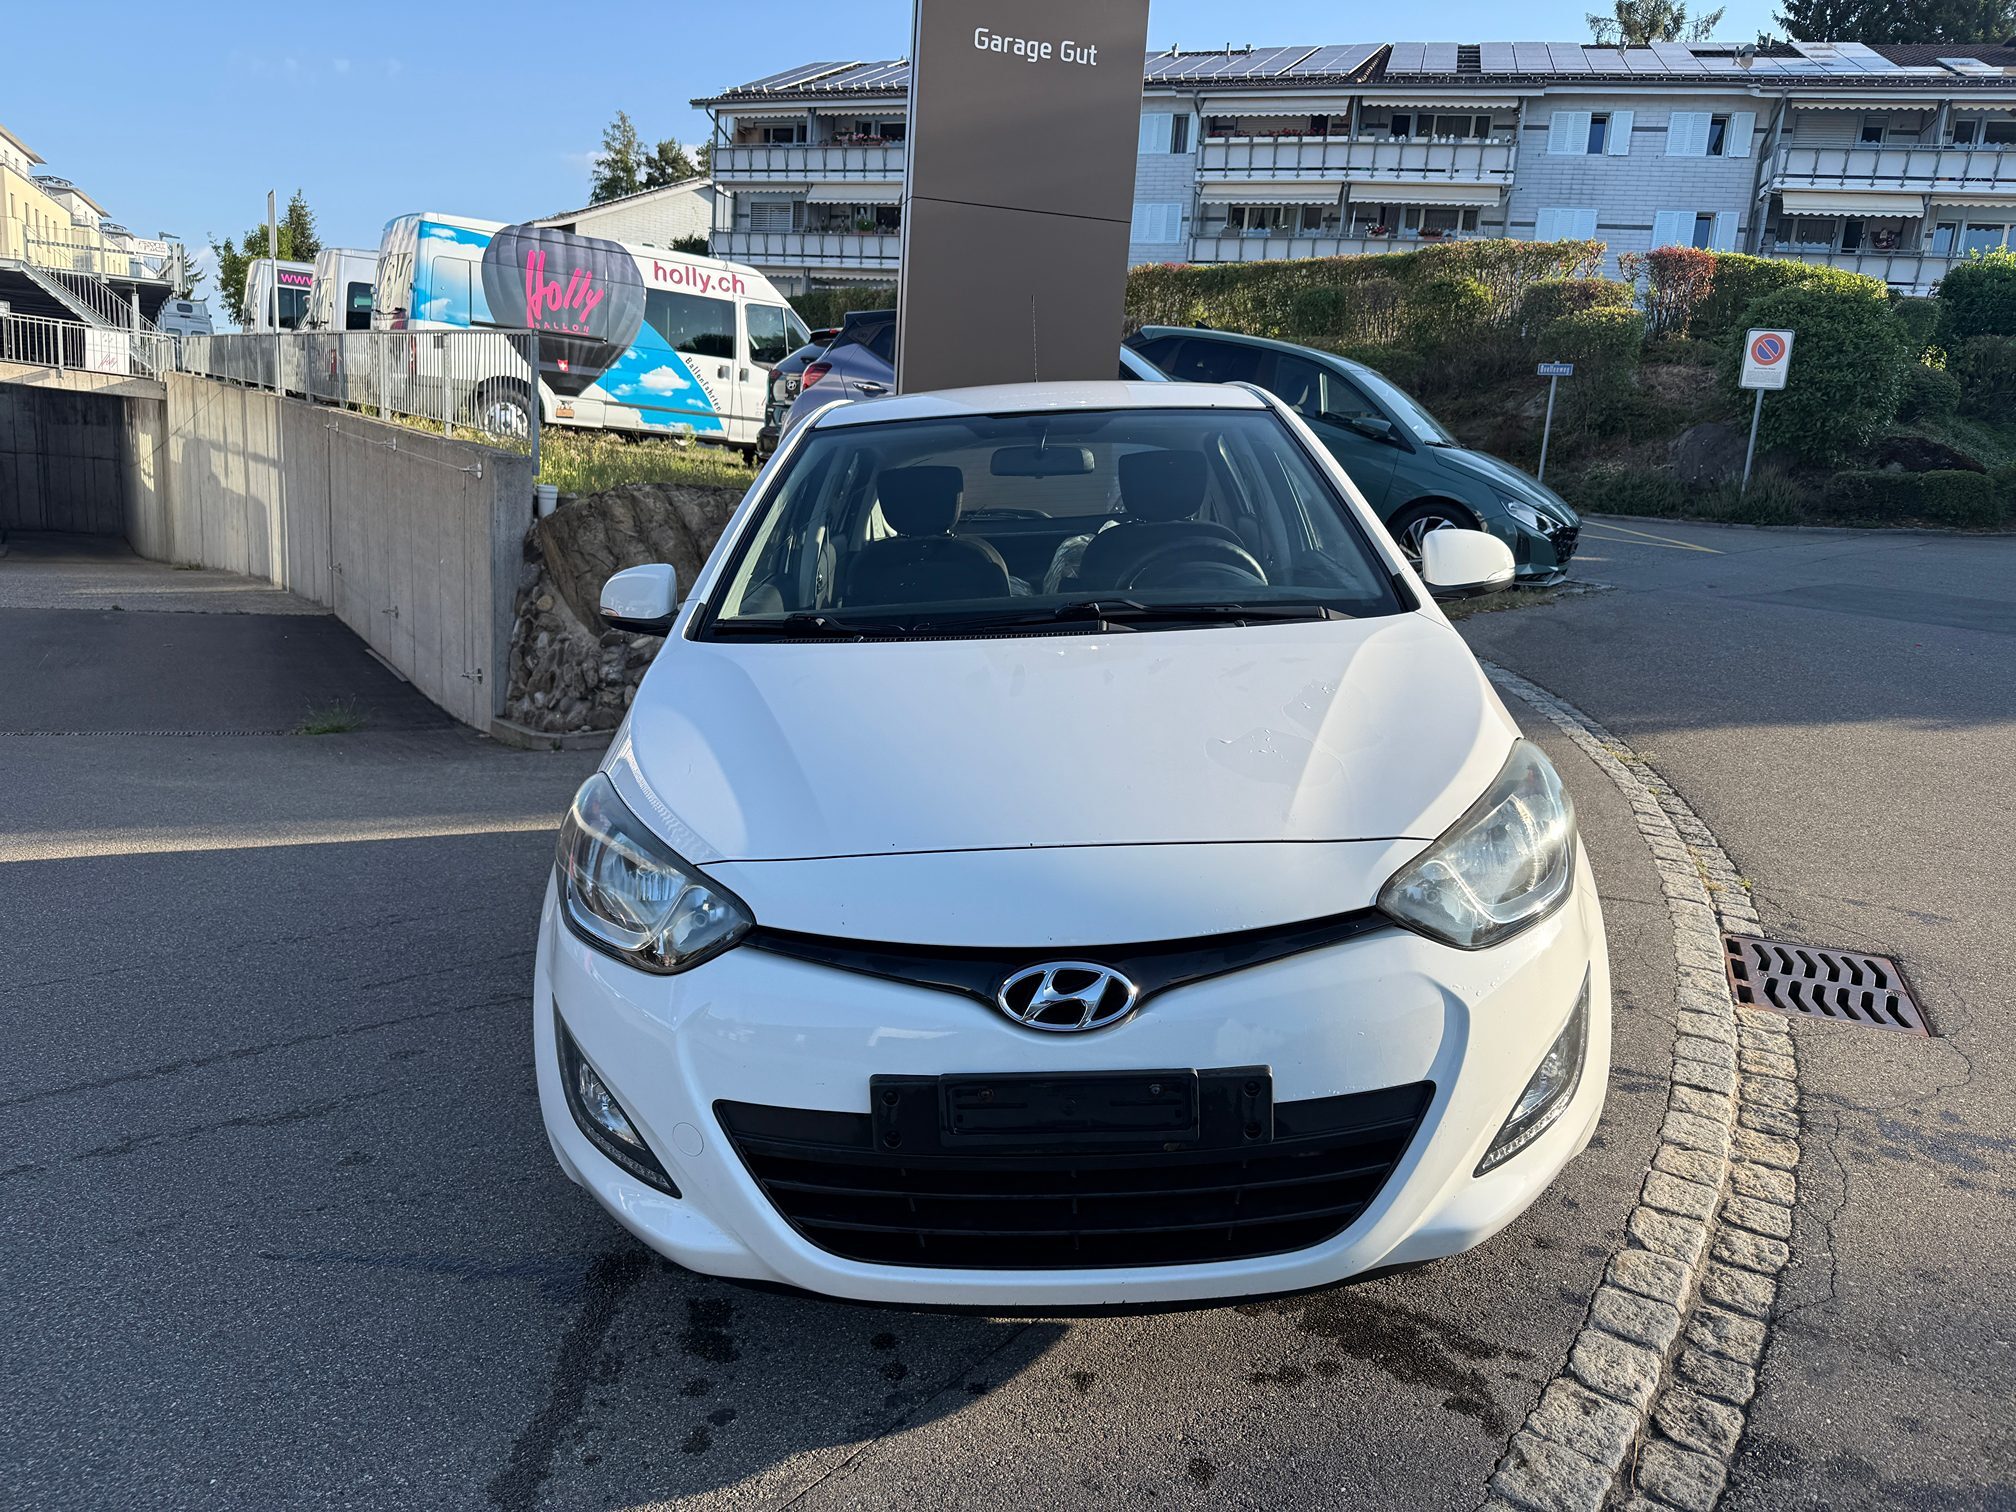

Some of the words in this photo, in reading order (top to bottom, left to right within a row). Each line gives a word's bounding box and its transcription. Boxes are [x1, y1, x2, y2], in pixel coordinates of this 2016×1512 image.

[974, 27, 1052, 63] Garage
[1060, 40, 1098, 66] Gut
[525, 249, 604, 328] Holly
[653, 260, 745, 295] holly.ch
[535, 321, 590, 333] BALLON
